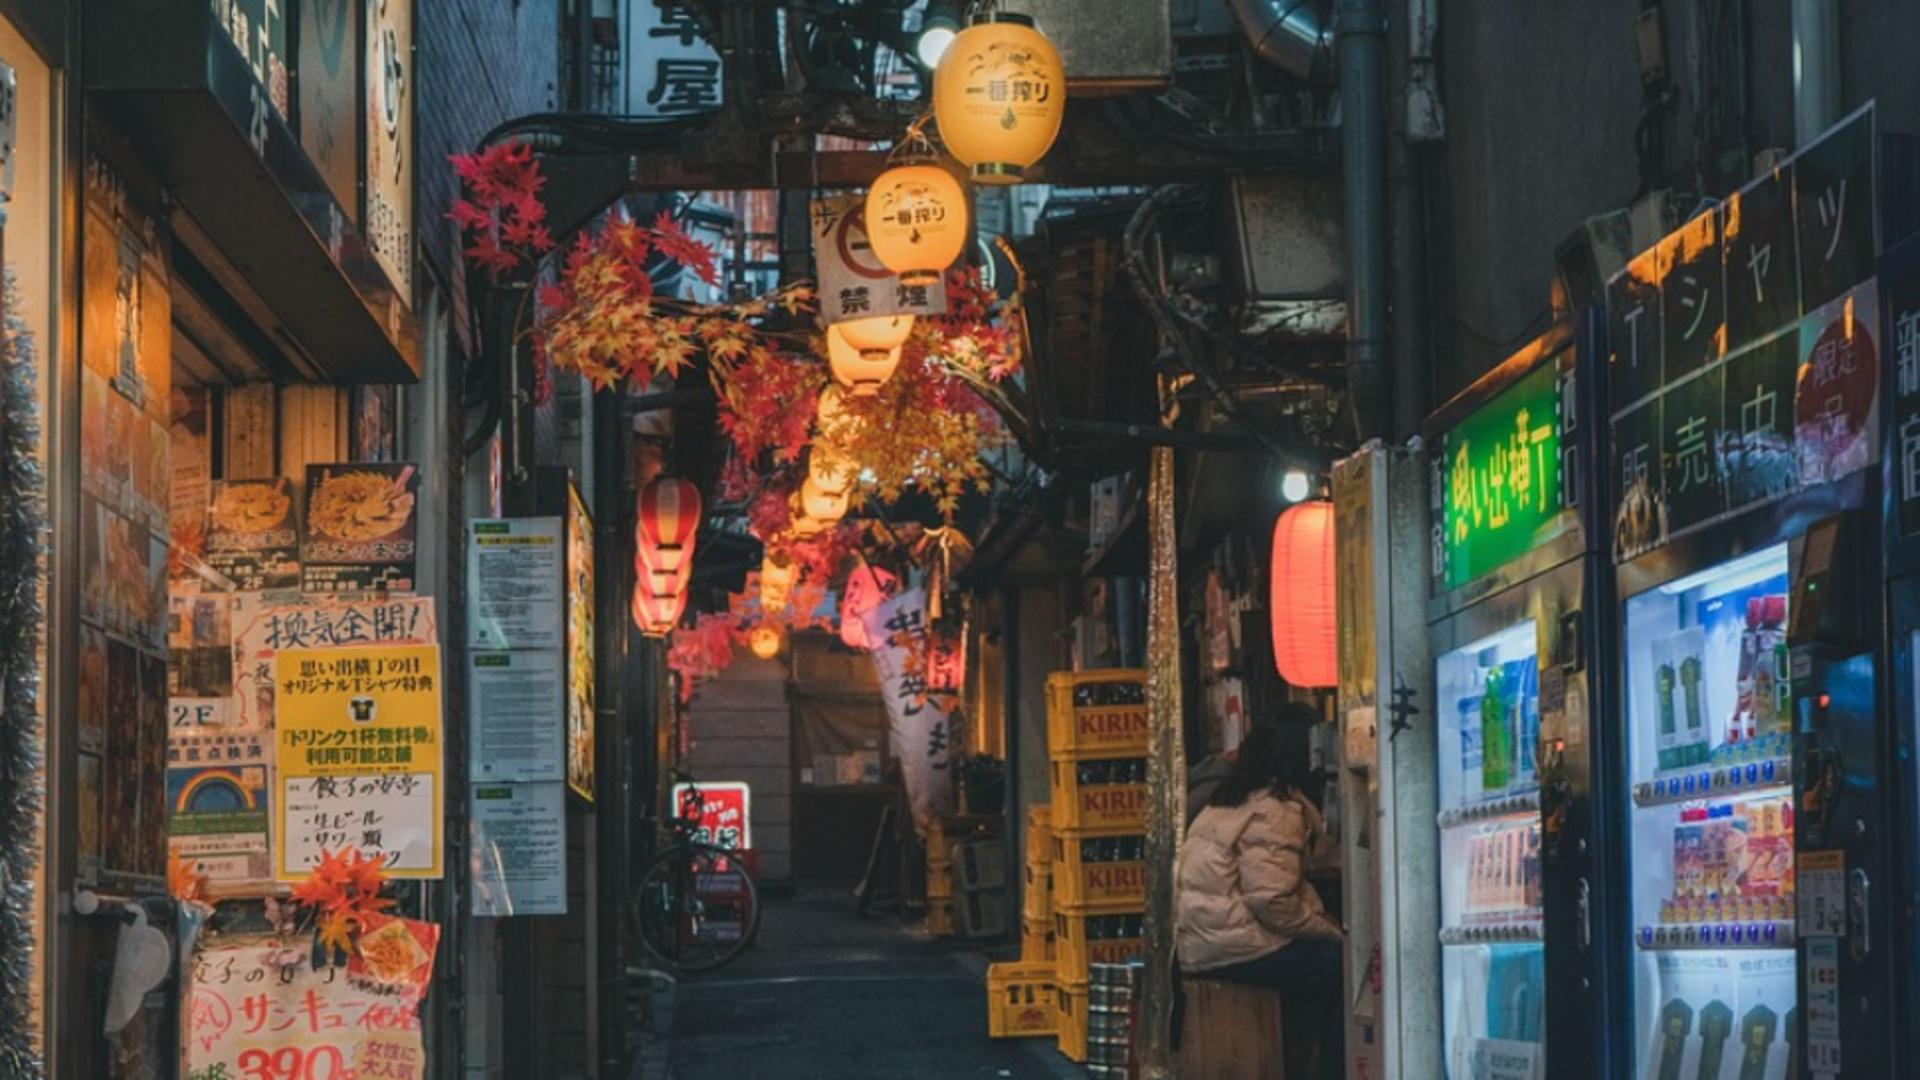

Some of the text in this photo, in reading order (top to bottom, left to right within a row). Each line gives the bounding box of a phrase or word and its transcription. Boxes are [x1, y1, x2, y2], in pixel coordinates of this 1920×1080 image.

[966, 80, 1049, 102] 一番搾り
[882, 208, 944, 225] 一番搾り
[840, 286, 928, 314] 禁煙
[1622, 383, 1776, 493] 販売中
[1453, 408, 1552, 546] 思い出横丁
[264, 606, 419, 648] 換気全開!
[299, 656, 419, 677] 思い出横丁の日
[282, 675, 433, 695] オリジナルTシャツ特典
[173, 706, 213, 726] 2F
[1080, 713, 1147, 734] KIRIN
[305, 746, 412, 765] 利用可能店舗
[1088, 865, 1145, 888] KIRI
